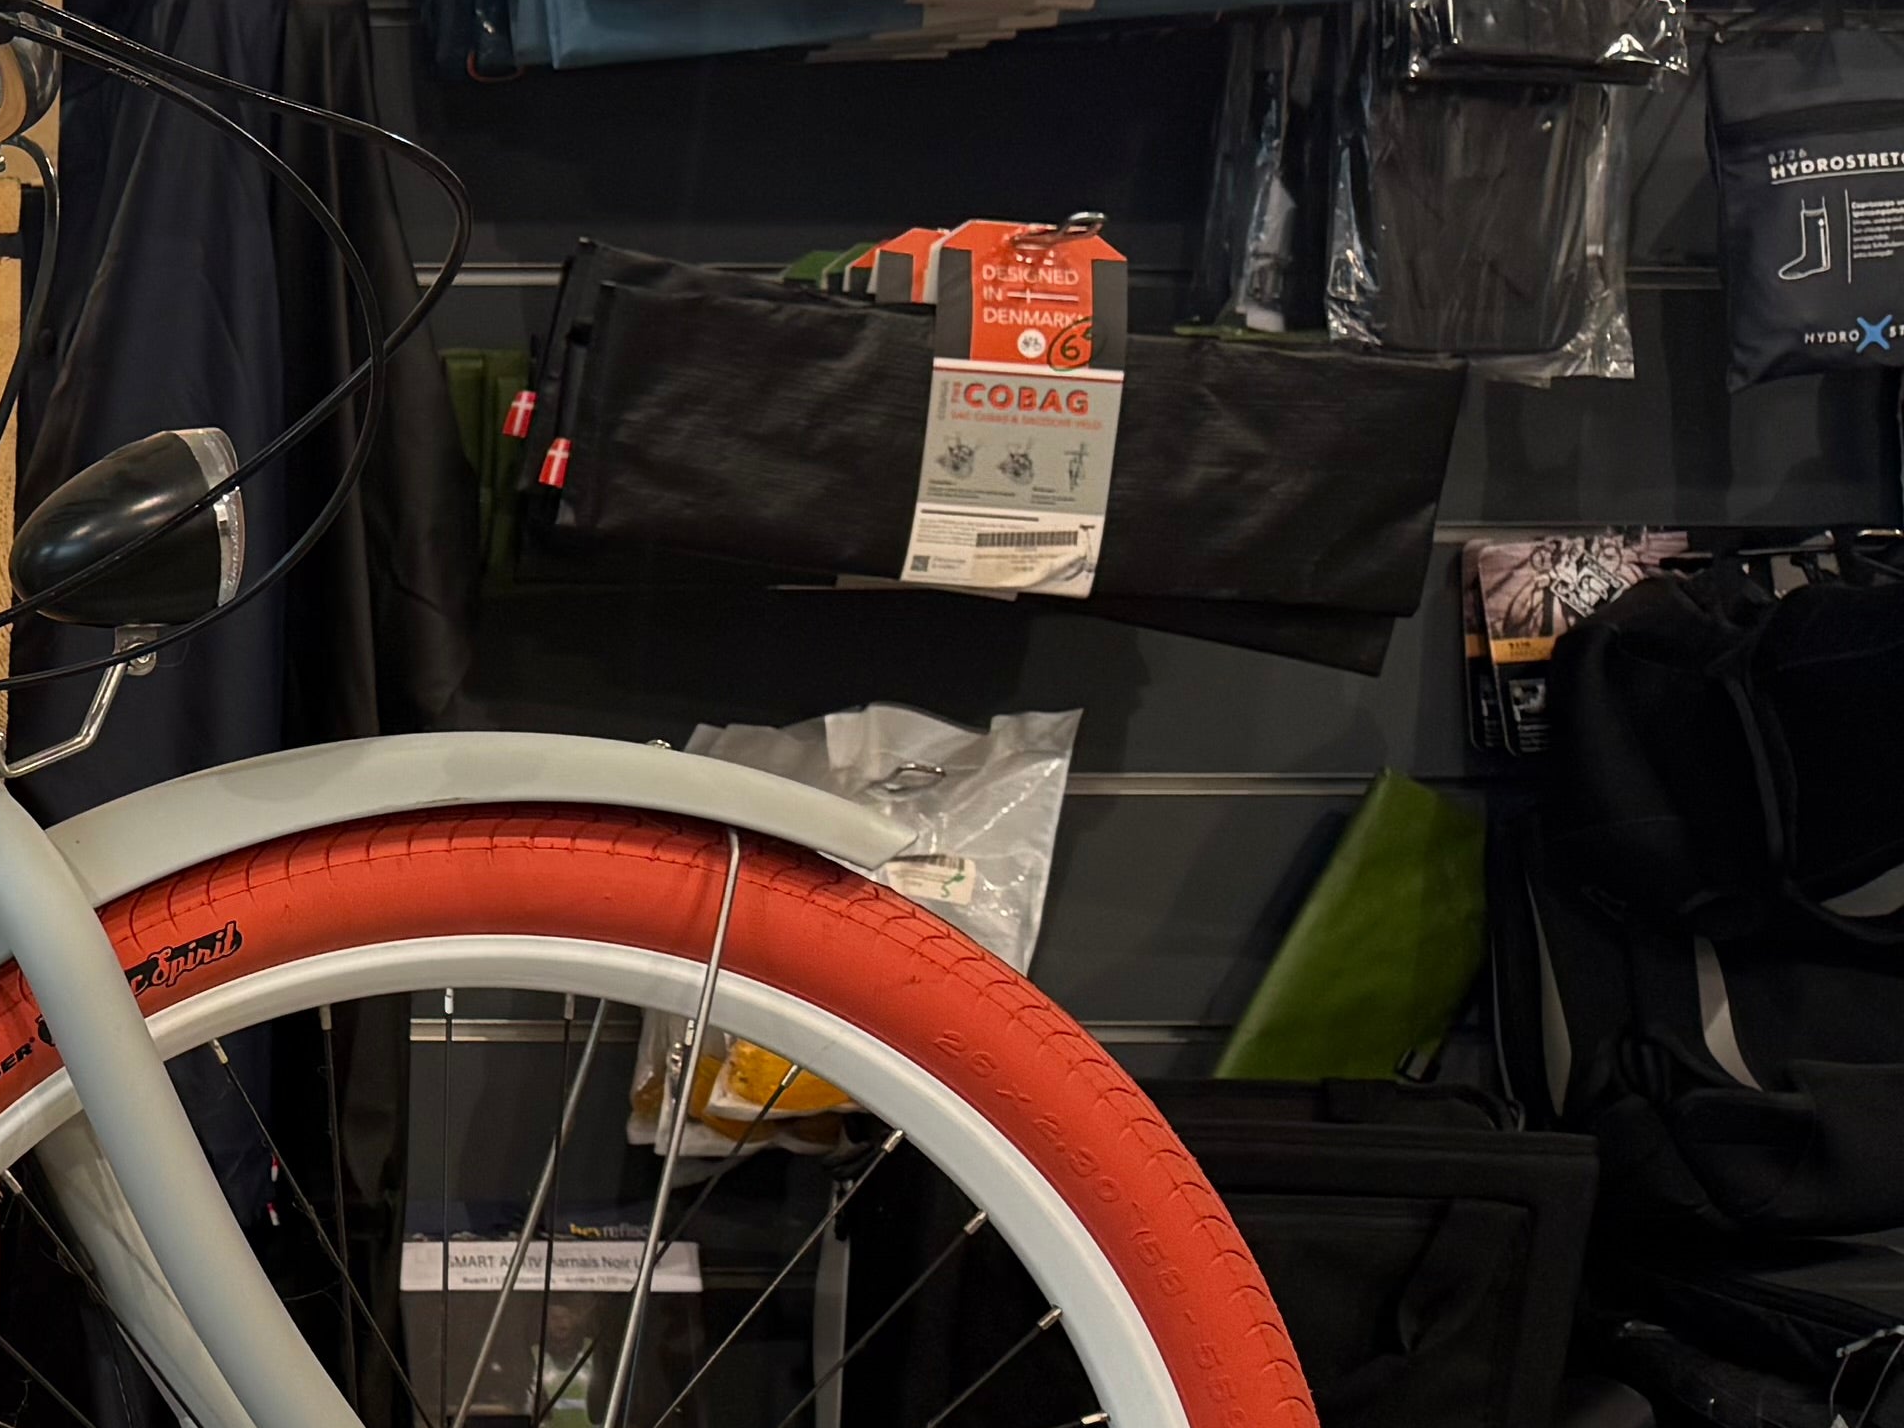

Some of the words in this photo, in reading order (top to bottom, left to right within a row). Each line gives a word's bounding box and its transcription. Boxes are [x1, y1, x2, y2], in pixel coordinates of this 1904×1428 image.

[982, 264, 1079, 285] DESIGNED
[983, 287, 1003, 302] IN
[964, 383, 1089, 415] COBAG
[151, 920, 239, 988] Spirit
